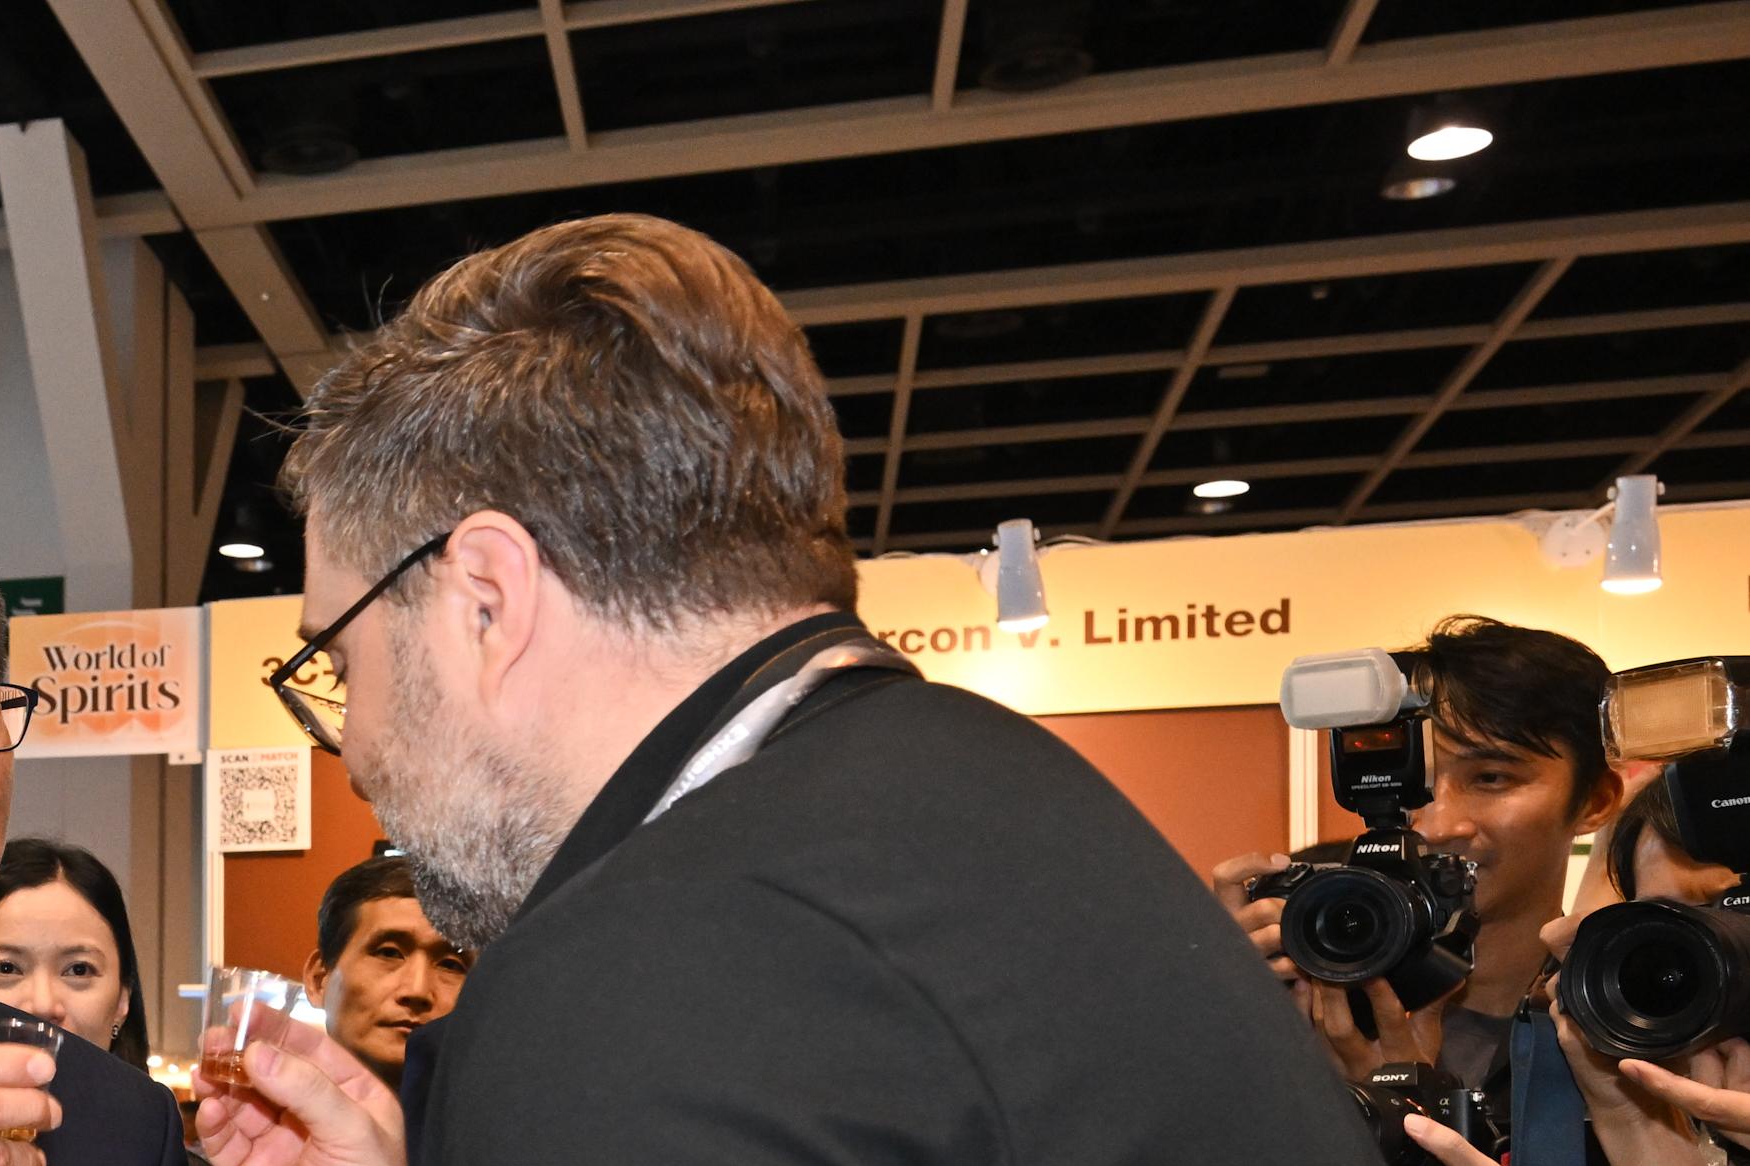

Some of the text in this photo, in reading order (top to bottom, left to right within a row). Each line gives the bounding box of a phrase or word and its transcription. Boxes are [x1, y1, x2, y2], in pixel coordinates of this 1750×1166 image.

[1083, 597, 1292, 646] Limited
[42, 642, 172, 672] World of
[30, 673, 182, 724] Spirits
[220, 753, 249, 764] SCAN
[1360, 774, 1392, 784] Nikon
[1356, 842, 1400, 854] Nikon
[1372, 1073, 1410, 1083] SONY
